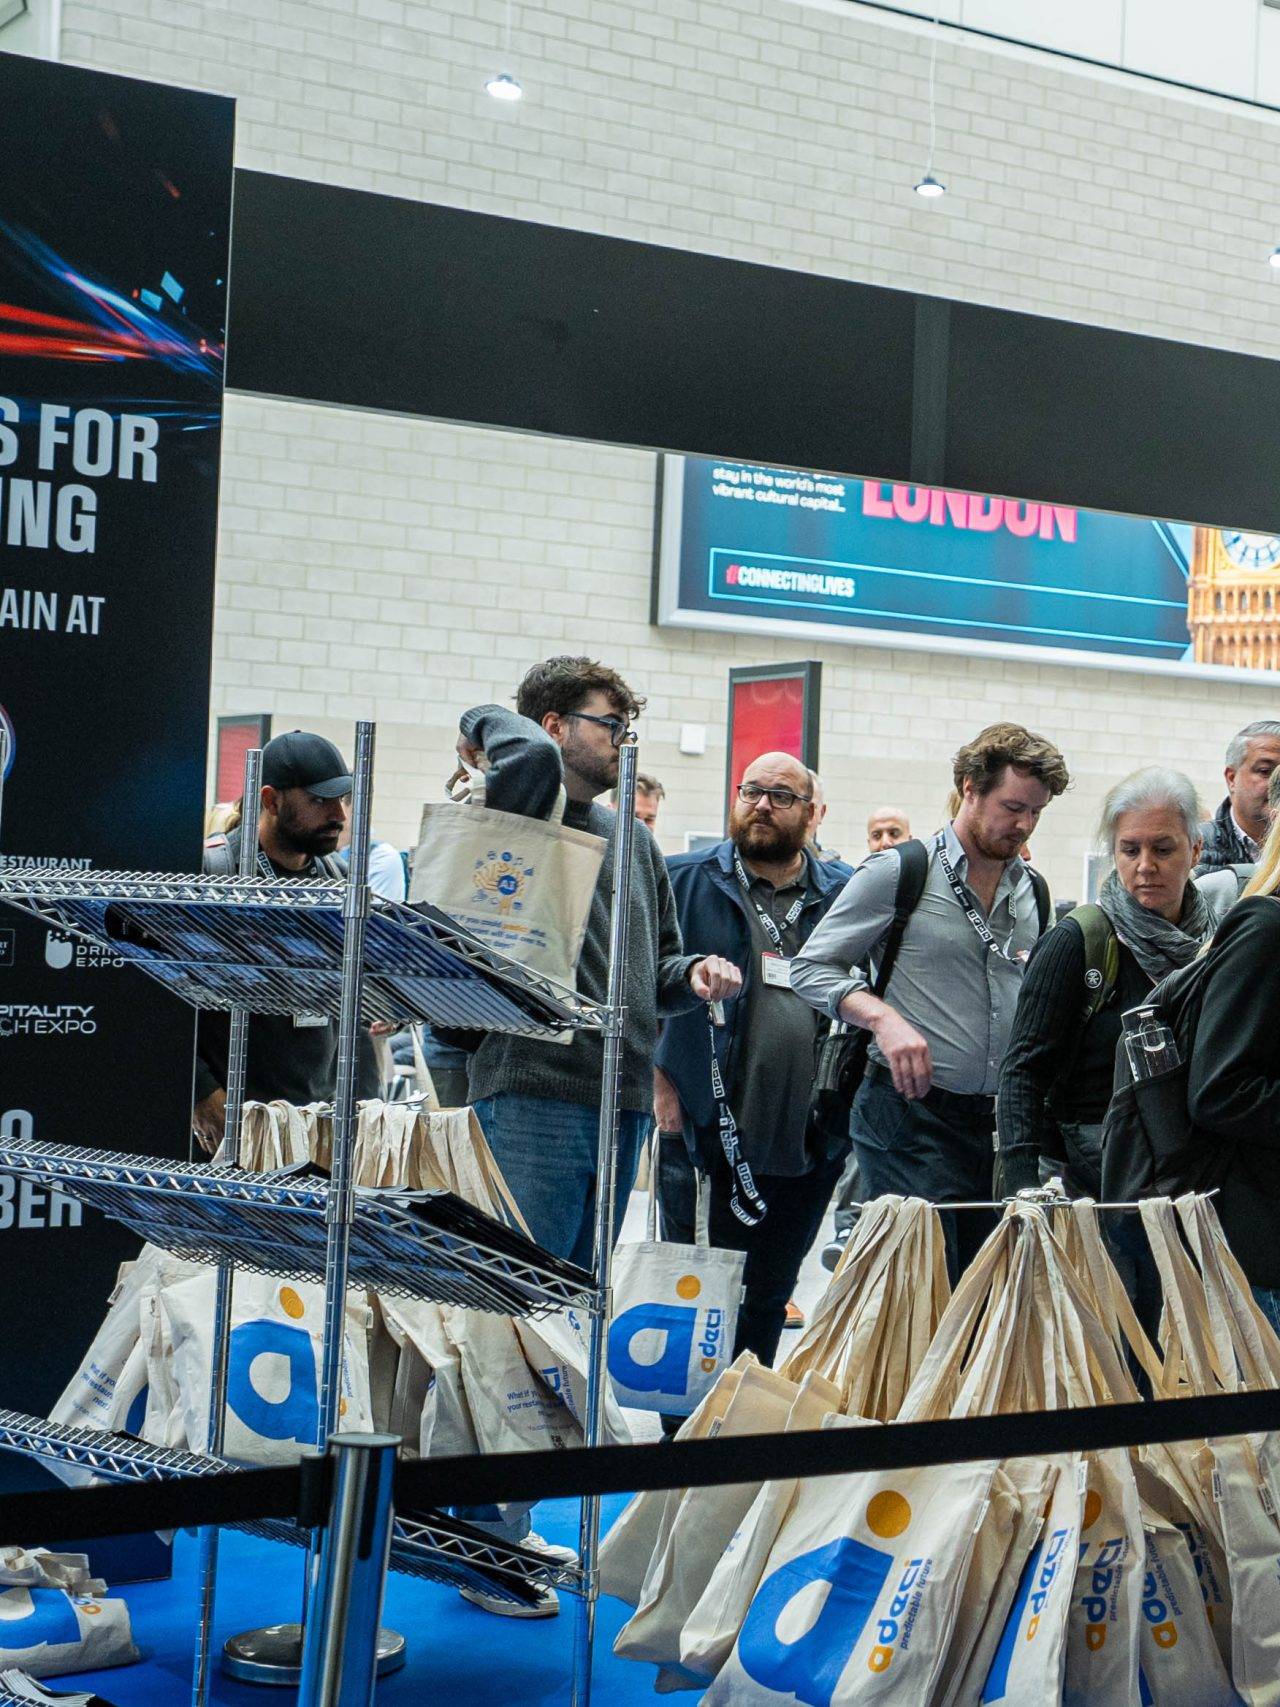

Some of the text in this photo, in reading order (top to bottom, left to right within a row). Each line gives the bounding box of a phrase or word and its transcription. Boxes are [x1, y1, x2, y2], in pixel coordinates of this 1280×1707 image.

[38, 403, 159, 483] FOR
[712, 483, 754, 500] vibrant
[755, 489, 798, 506] cultural
[713, 467, 739, 484] stay
[741, 470, 751, 483] in
[753, 472, 773, 486] the
[775, 476, 814, 492] world's
[815, 482, 845, 496] most
[0, 477, 97, 554] NG
[863, 479, 1077, 543] LONDON
[65, 595, 105, 635] AT
[76, 957, 124, 968] EXPO
[34, 1020, 97, 1034] EXPO
[868, 1558, 923, 1673] adeci
[900, 1558, 933, 1650] predictable future
[1110, 1563, 1123, 1622] predictable
[1156, 1564, 1183, 1617] predictable
